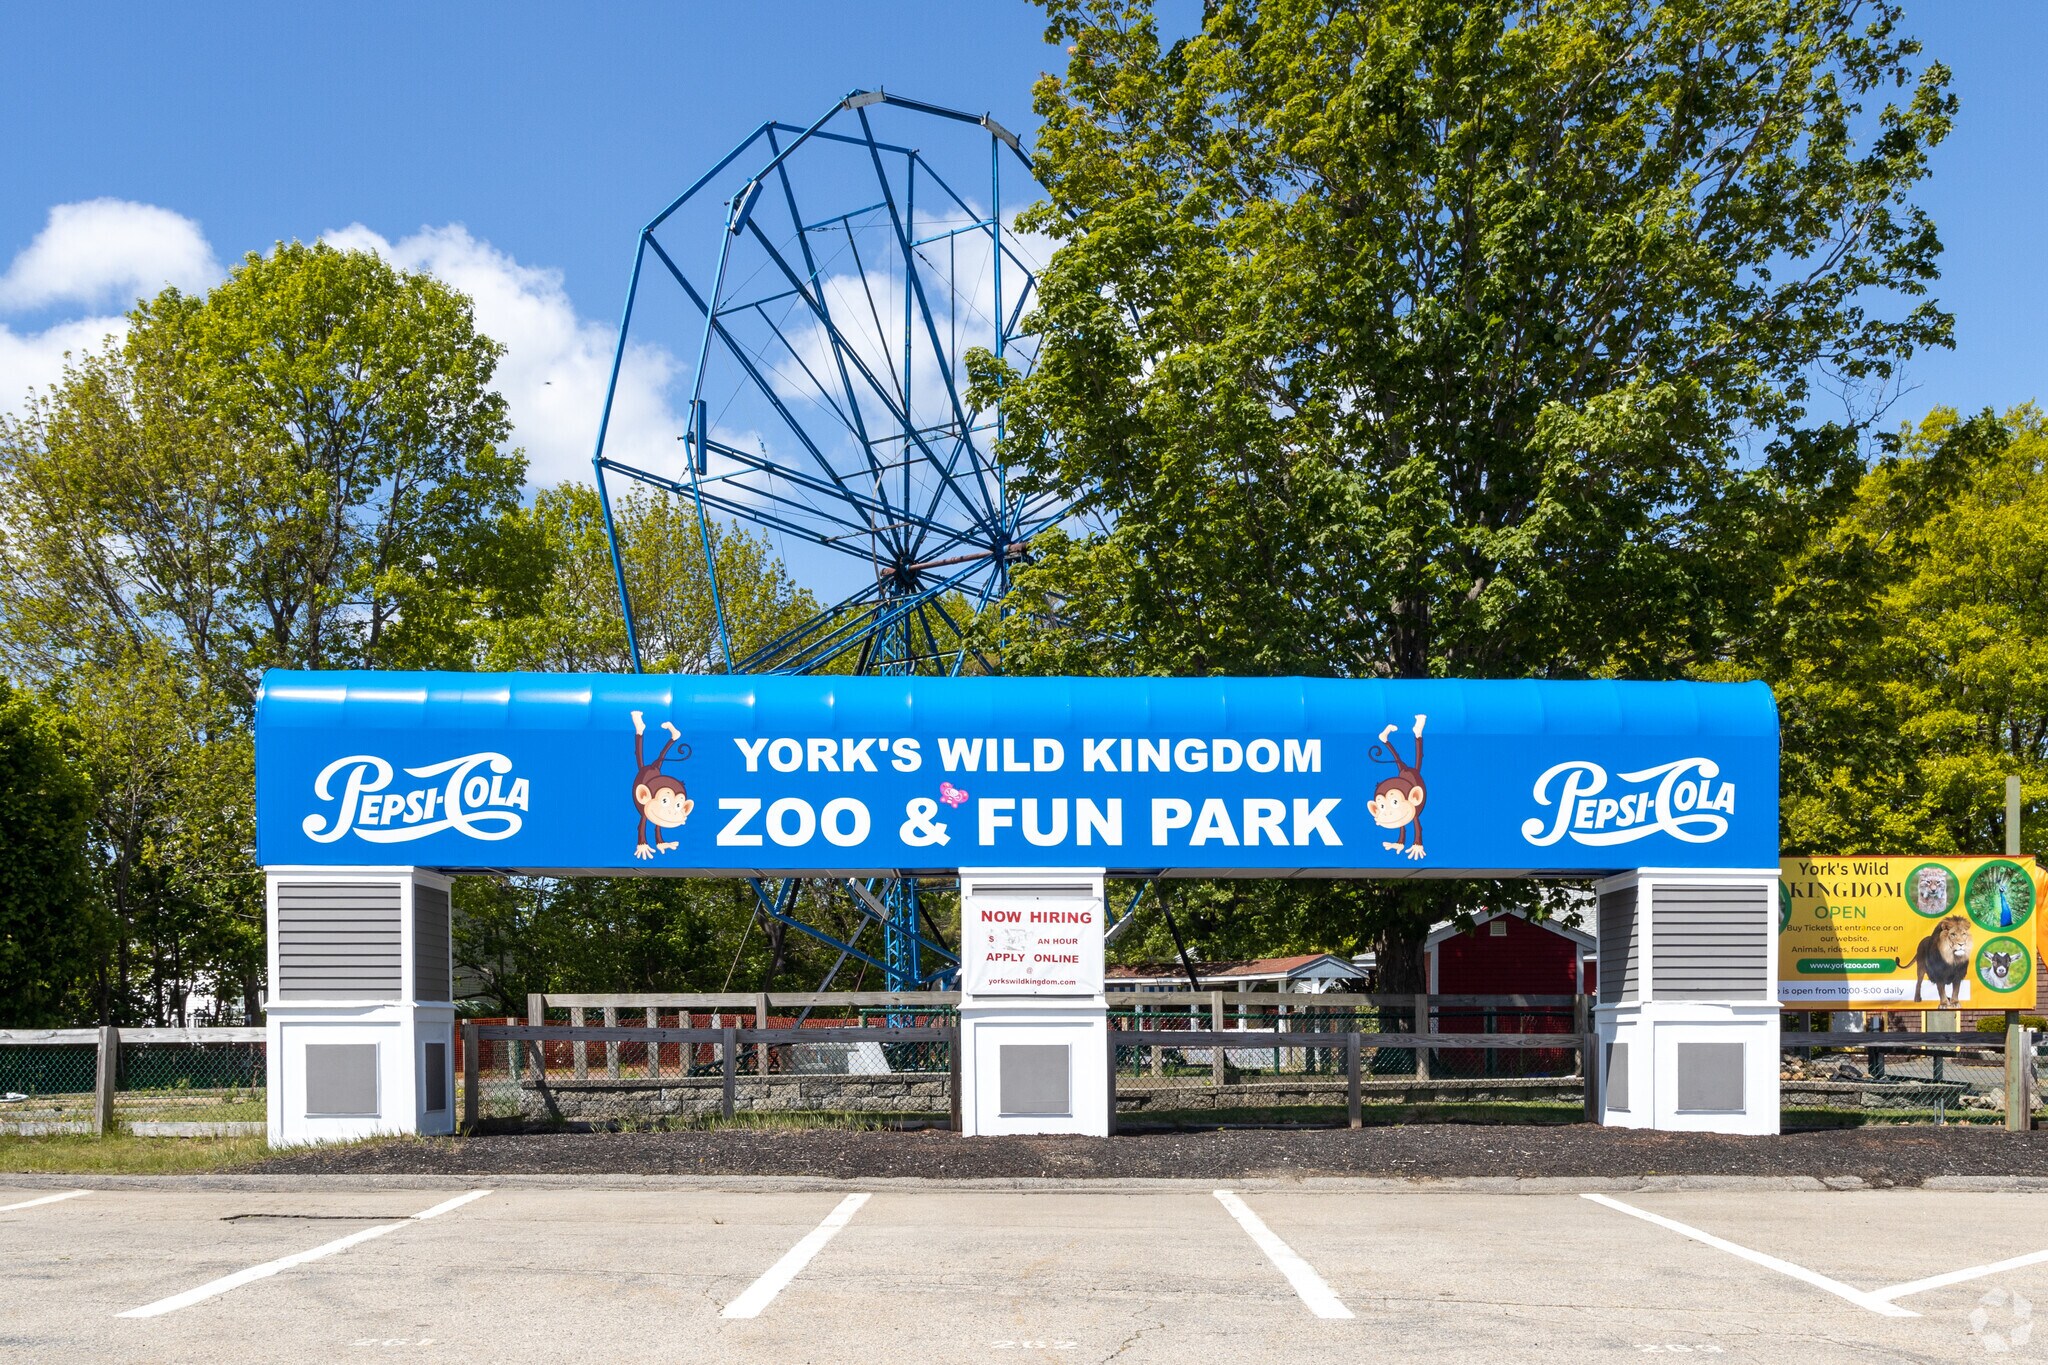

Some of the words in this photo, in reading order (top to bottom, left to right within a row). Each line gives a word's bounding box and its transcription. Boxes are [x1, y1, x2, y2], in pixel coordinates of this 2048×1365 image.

[734, 738, 921, 772] YORK'S
[938, 738, 1064, 771] WILD
[1083, 738, 1322, 772] KINGDOM
[717, 799, 871, 847] ZOO
[900, 801, 949, 847] &
[979, 799, 1122, 846] FUN
[1152, 799, 1343, 846] PARK
[1798, 862, 1848, 875] York's
[1853, 862, 1889, 875] Wild
[1790, 882, 1902, 898] KINGDOM
[981, 910, 1022, 923] NOW
[1030, 911, 1092, 924] HIRING
[1815, 905, 1866, 919] OPEN
[1786, 924, 1802, 932] Buy
[986, 952, 1026, 963] APPLY
[1034, 953, 1080, 964] ONLINE
[1026, 967, 1034, 975] @
[1809, 962, 1880, 970] www.yorkzoo.com
[988, 978, 1076, 987] yorkswildkingdom.com
[1791, 988, 1814, 996] open
[1883, 987, 1904, 996] daily
